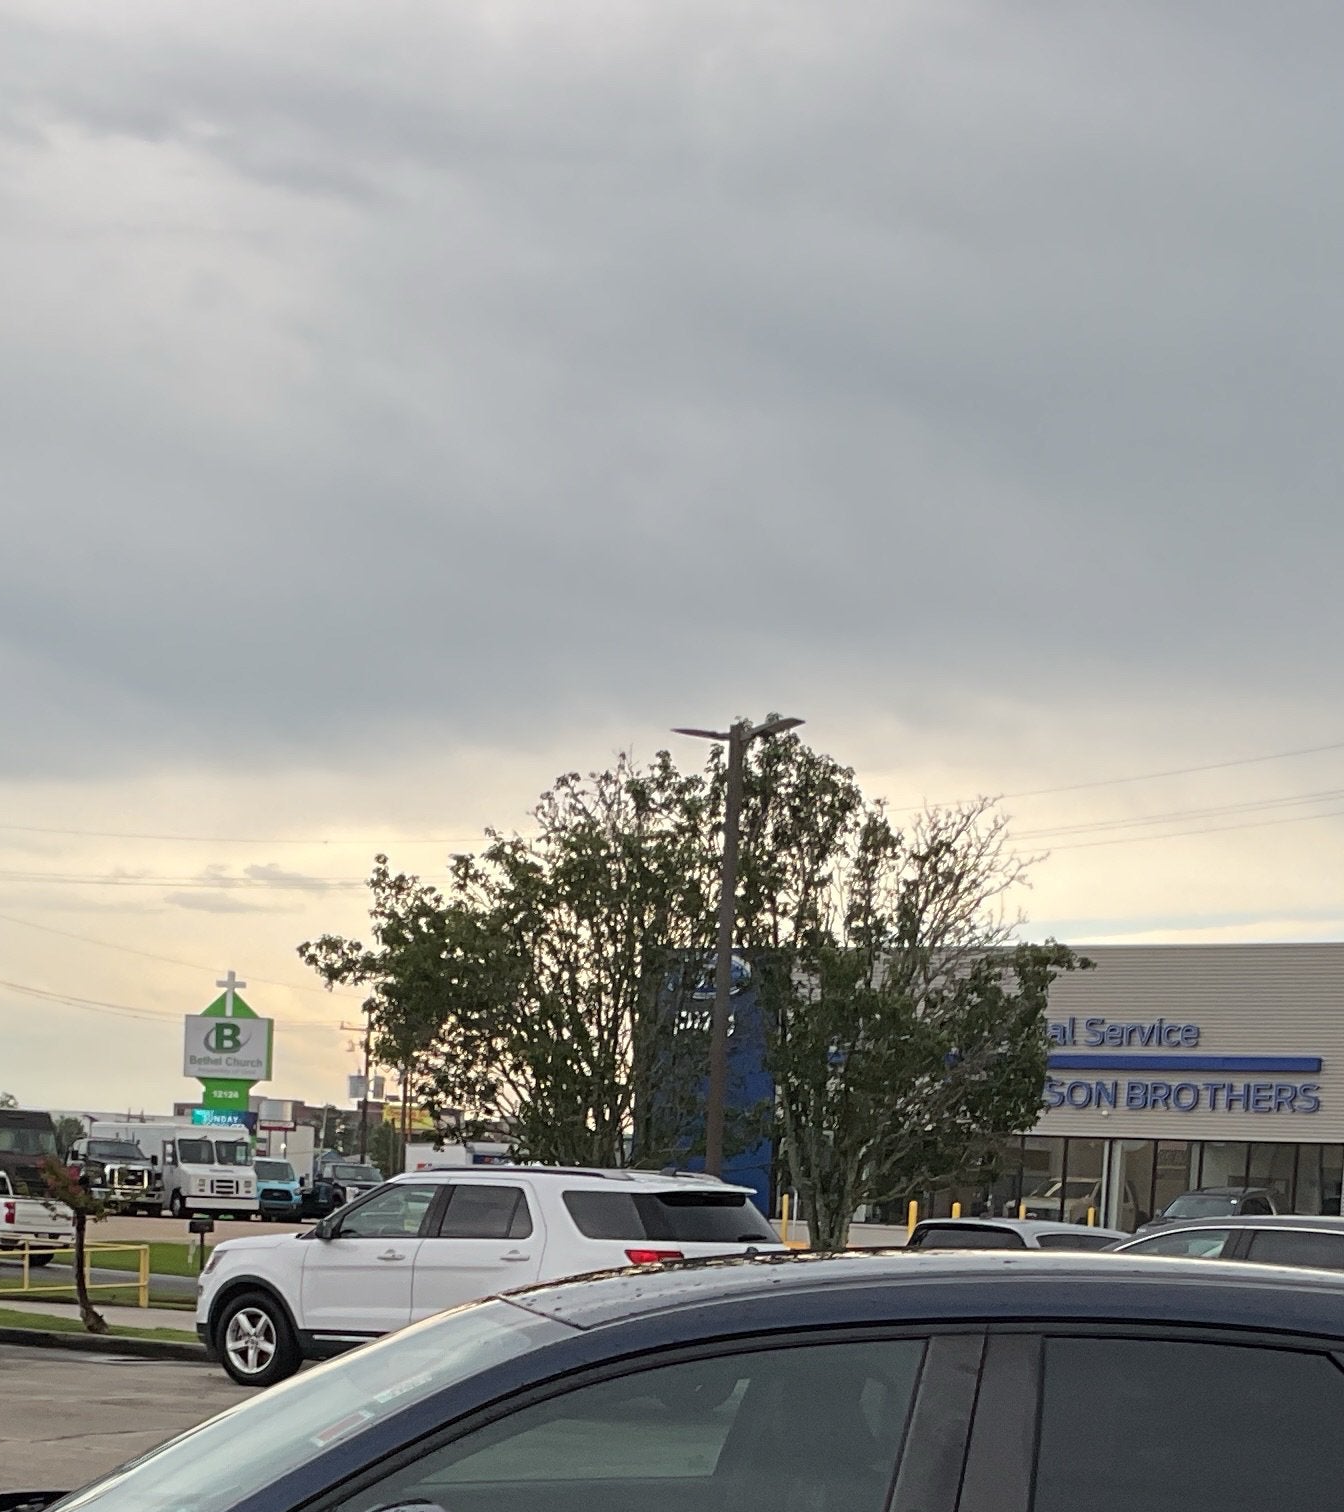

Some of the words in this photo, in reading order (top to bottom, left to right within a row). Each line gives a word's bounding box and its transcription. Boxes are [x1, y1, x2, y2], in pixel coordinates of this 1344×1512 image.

[1084, 1017, 1200, 1047] Service
[189, 1054, 222, 1066] Bethel
[225, 1056, 263, 1068] Church
[1125, 1080, 1321, 1113] BROTHERS
